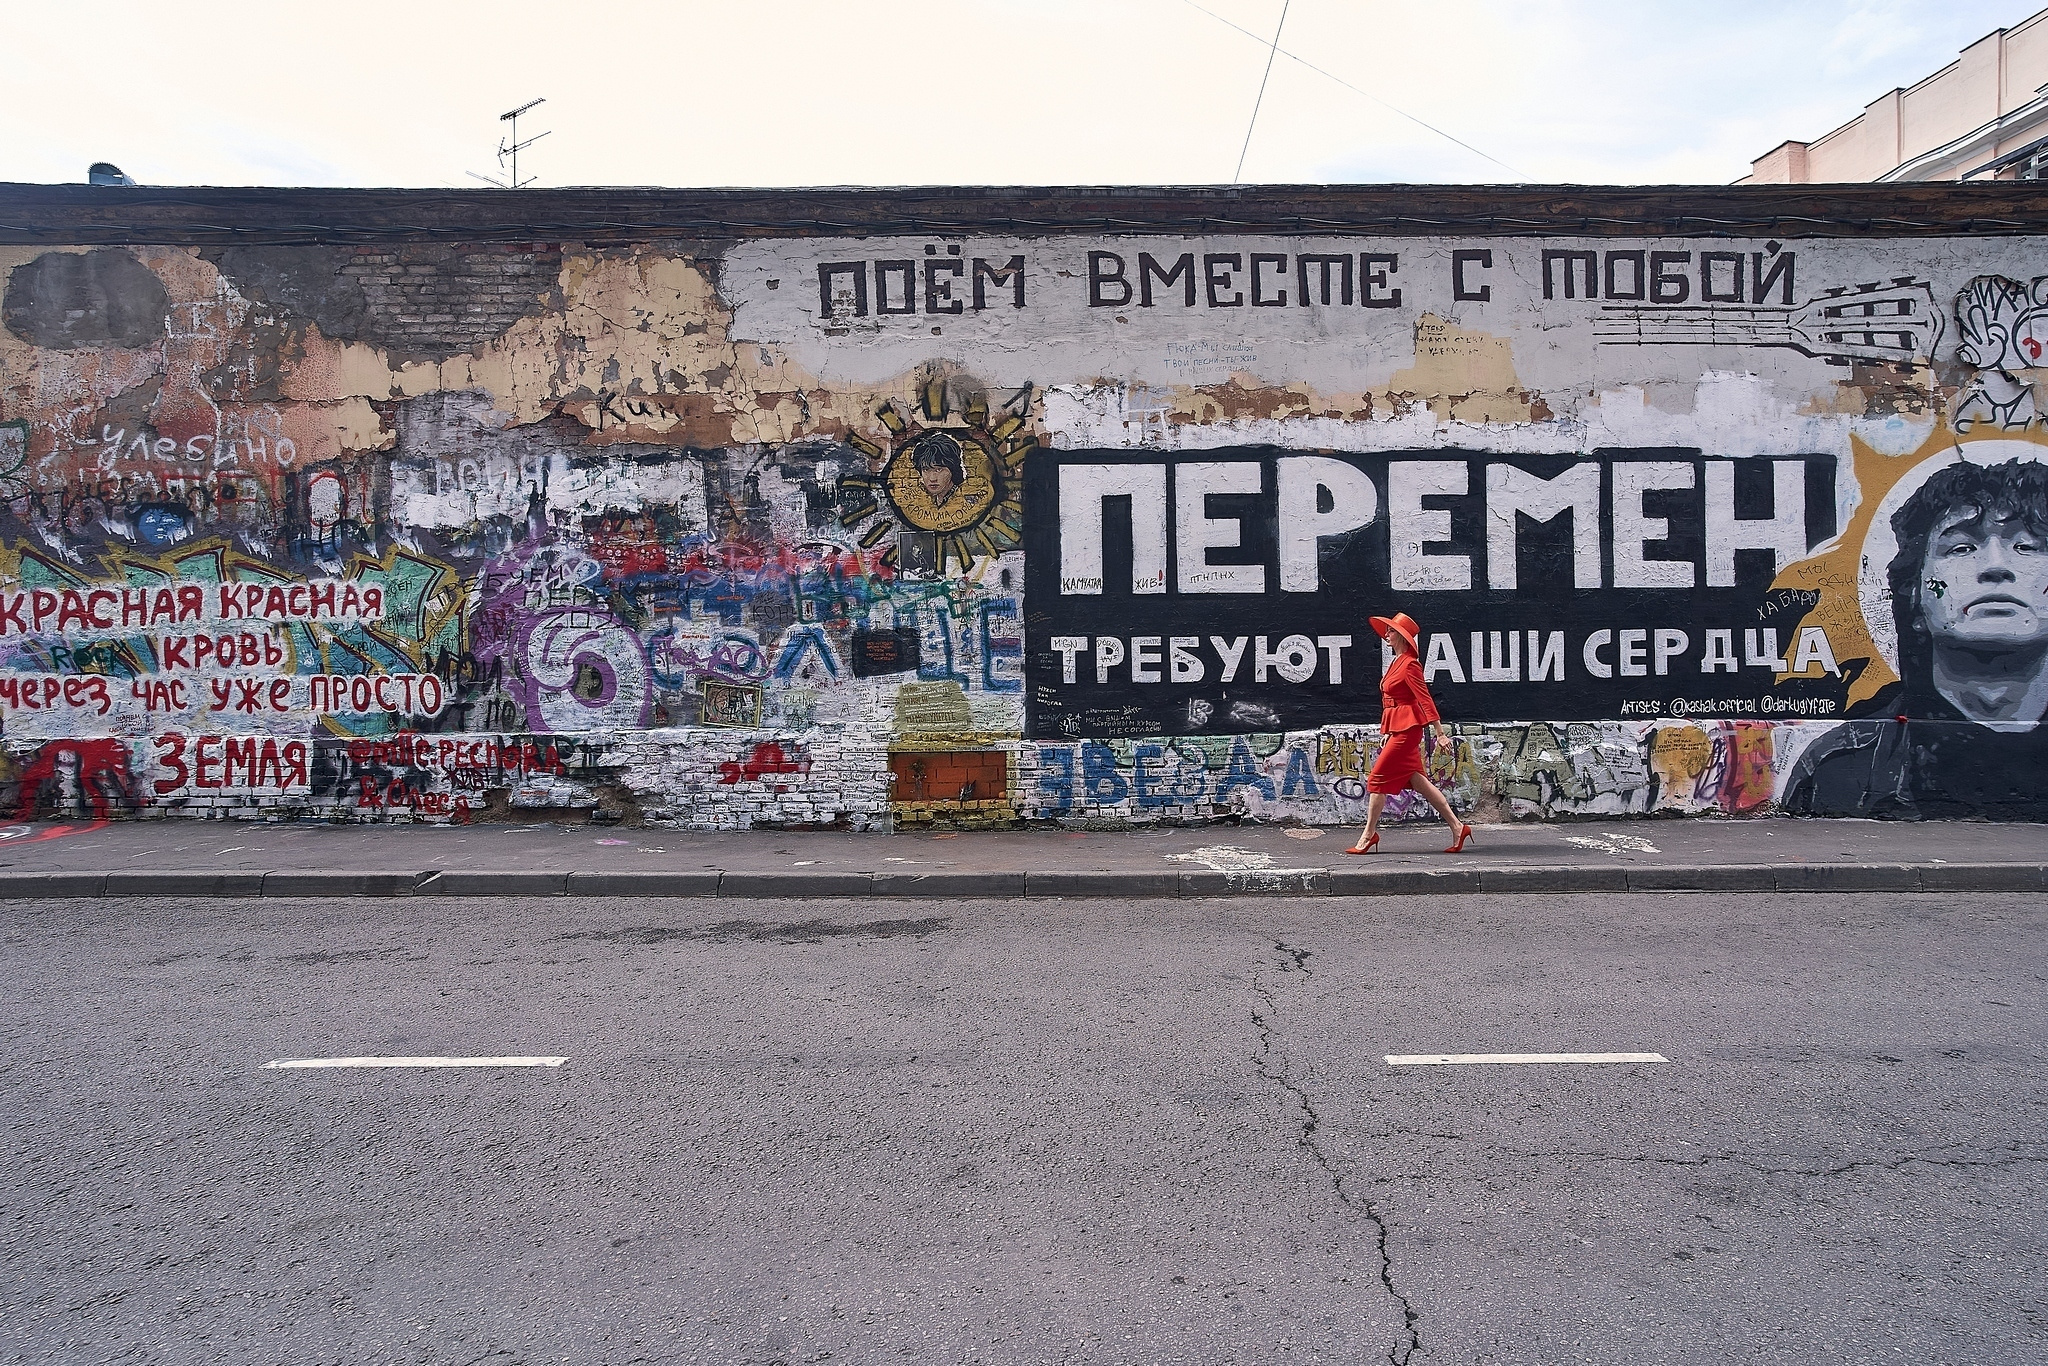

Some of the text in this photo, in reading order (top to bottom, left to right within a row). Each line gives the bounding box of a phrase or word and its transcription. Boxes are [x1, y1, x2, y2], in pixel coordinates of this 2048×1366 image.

[817, 240, 1797, 319] ПОЁМ ВМЕСТЕ С ТОБОЙ
[1058, 456, 1804, 595] ПЕРЕМЕН
[0, 585, 204, 635] КРАСНАЯ
[221, 582, 384, 620] КРАСНАЯ
[163, 632, 282, 669] КРОВЬ
[1050, 633, 1353, 685] ТРЕБУЮТ
[1583, 626, 1842, 679] СЕРДЦА
[309, 675, 441, 716] ПРОСТО
[153, 732, 307, 794] ЗЕМЛЯ
